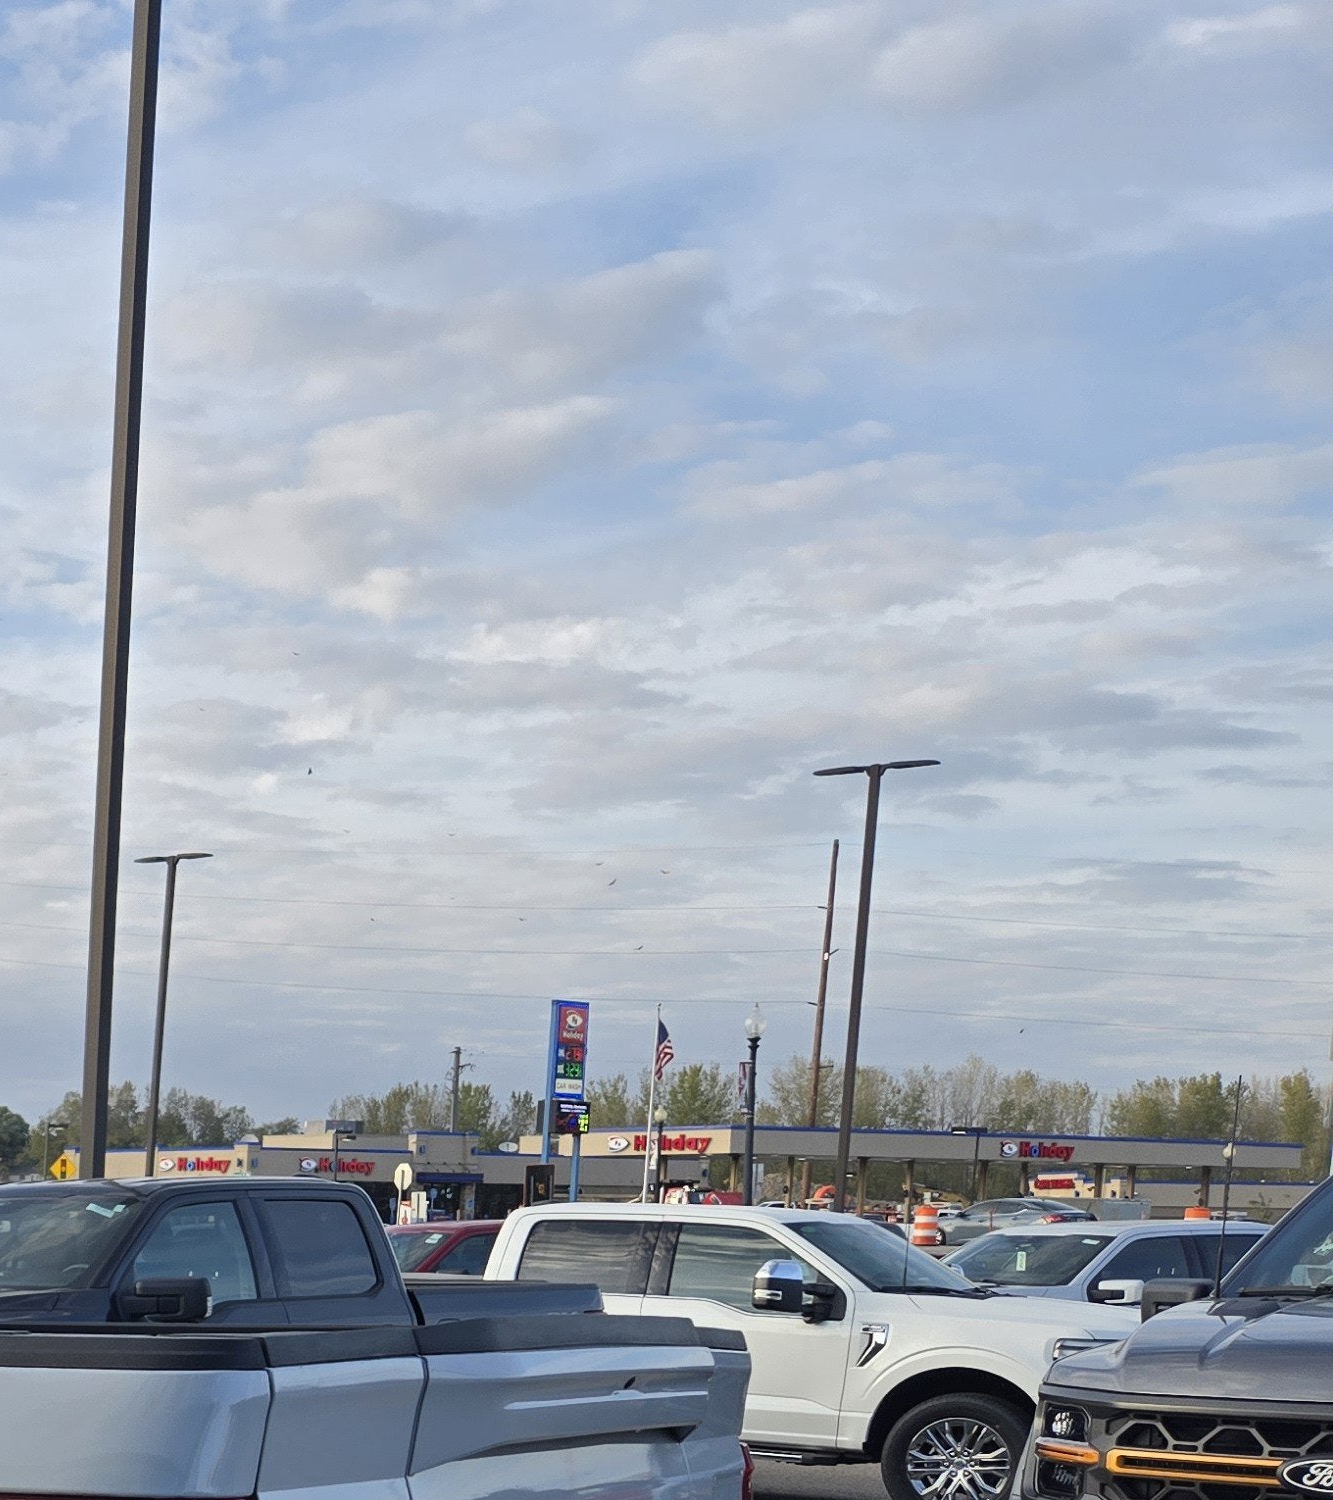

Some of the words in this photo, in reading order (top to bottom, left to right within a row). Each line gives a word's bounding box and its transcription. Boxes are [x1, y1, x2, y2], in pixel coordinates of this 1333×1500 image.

[634, 1134, 712, 1154] Hliday
[1019, 1141, 1075, 1162] Holiday
[177, 1157, 231, 1174] Holiday
